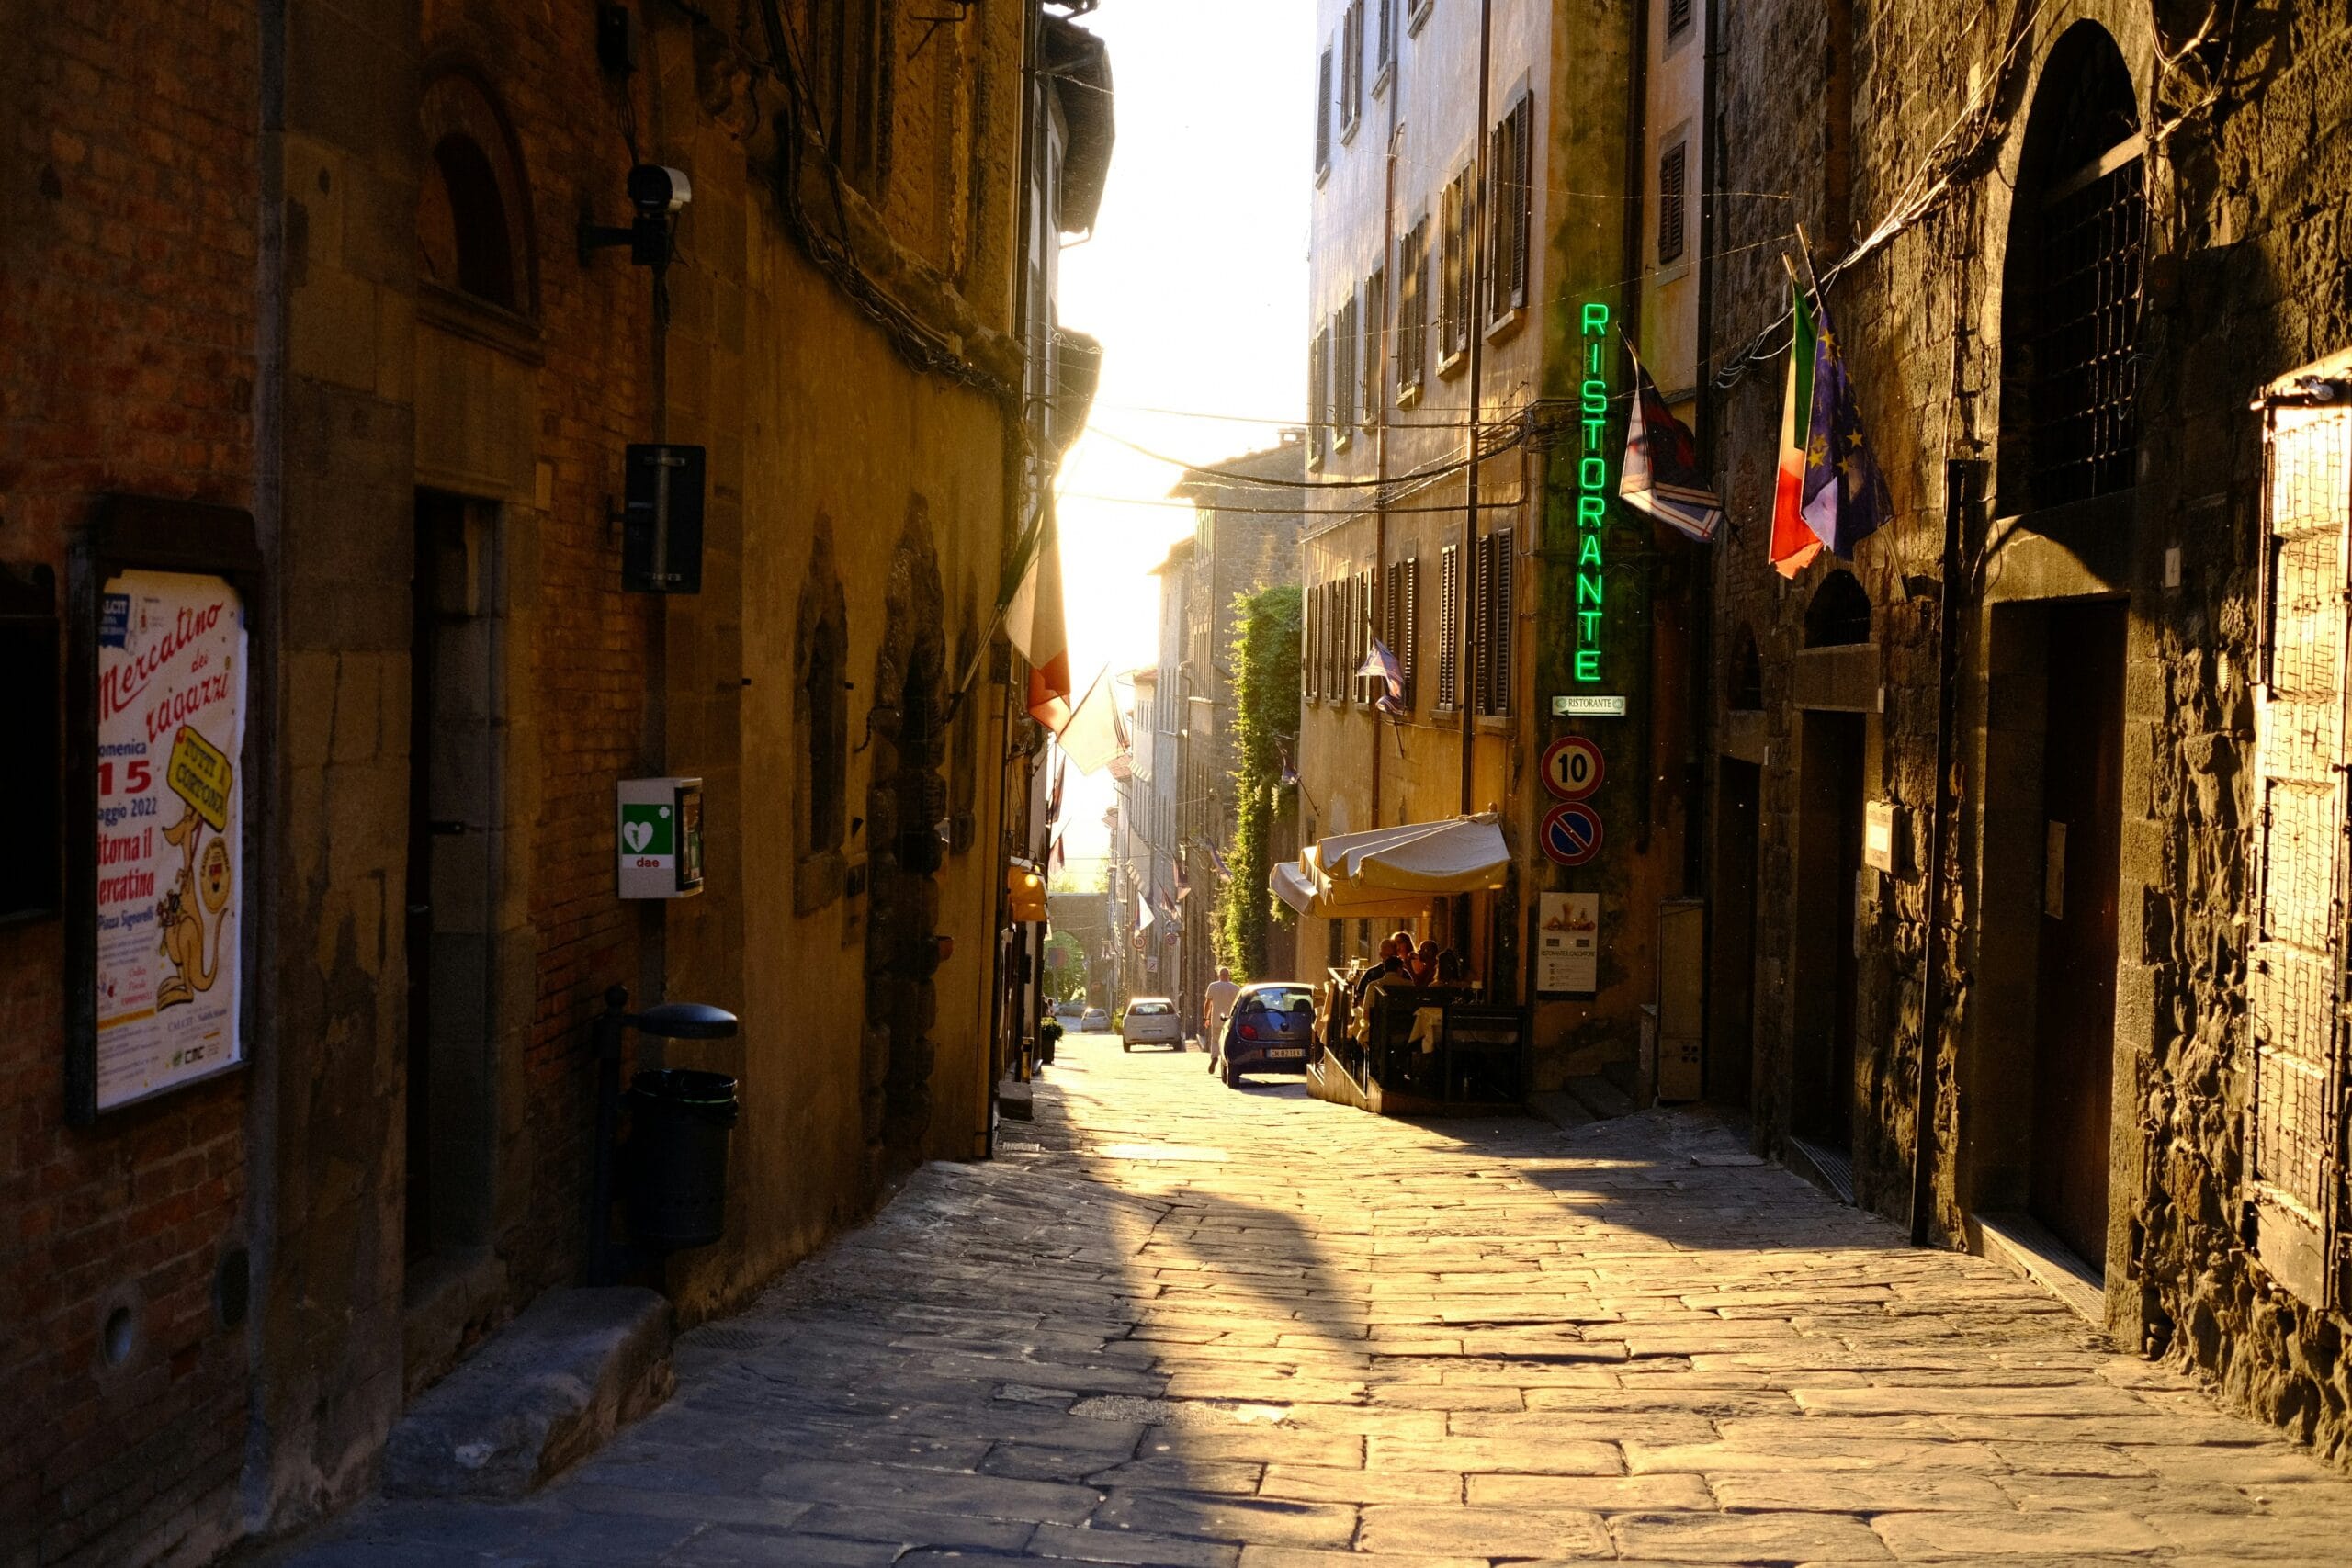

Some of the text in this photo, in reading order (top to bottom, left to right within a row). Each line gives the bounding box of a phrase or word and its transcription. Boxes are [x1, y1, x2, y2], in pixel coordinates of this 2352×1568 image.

[1575, 302, 1609, 682] RISTORANTE
[97, 602, 223, 724] Mercatino
[191, 649, 209, 673] dei
[146, 666, 230, 744] ragazzi
[1568, 698, 1612, 708] RISTORANTE
[97, 761, 152, 795] 15
[1558, 753, 1587, 783] 10
[130, 797, 157, 818] 2022
[143, 826, 152, 859] il
[636, 857, 660, 868] dae
[98, 869, 154, 906] ercatino
